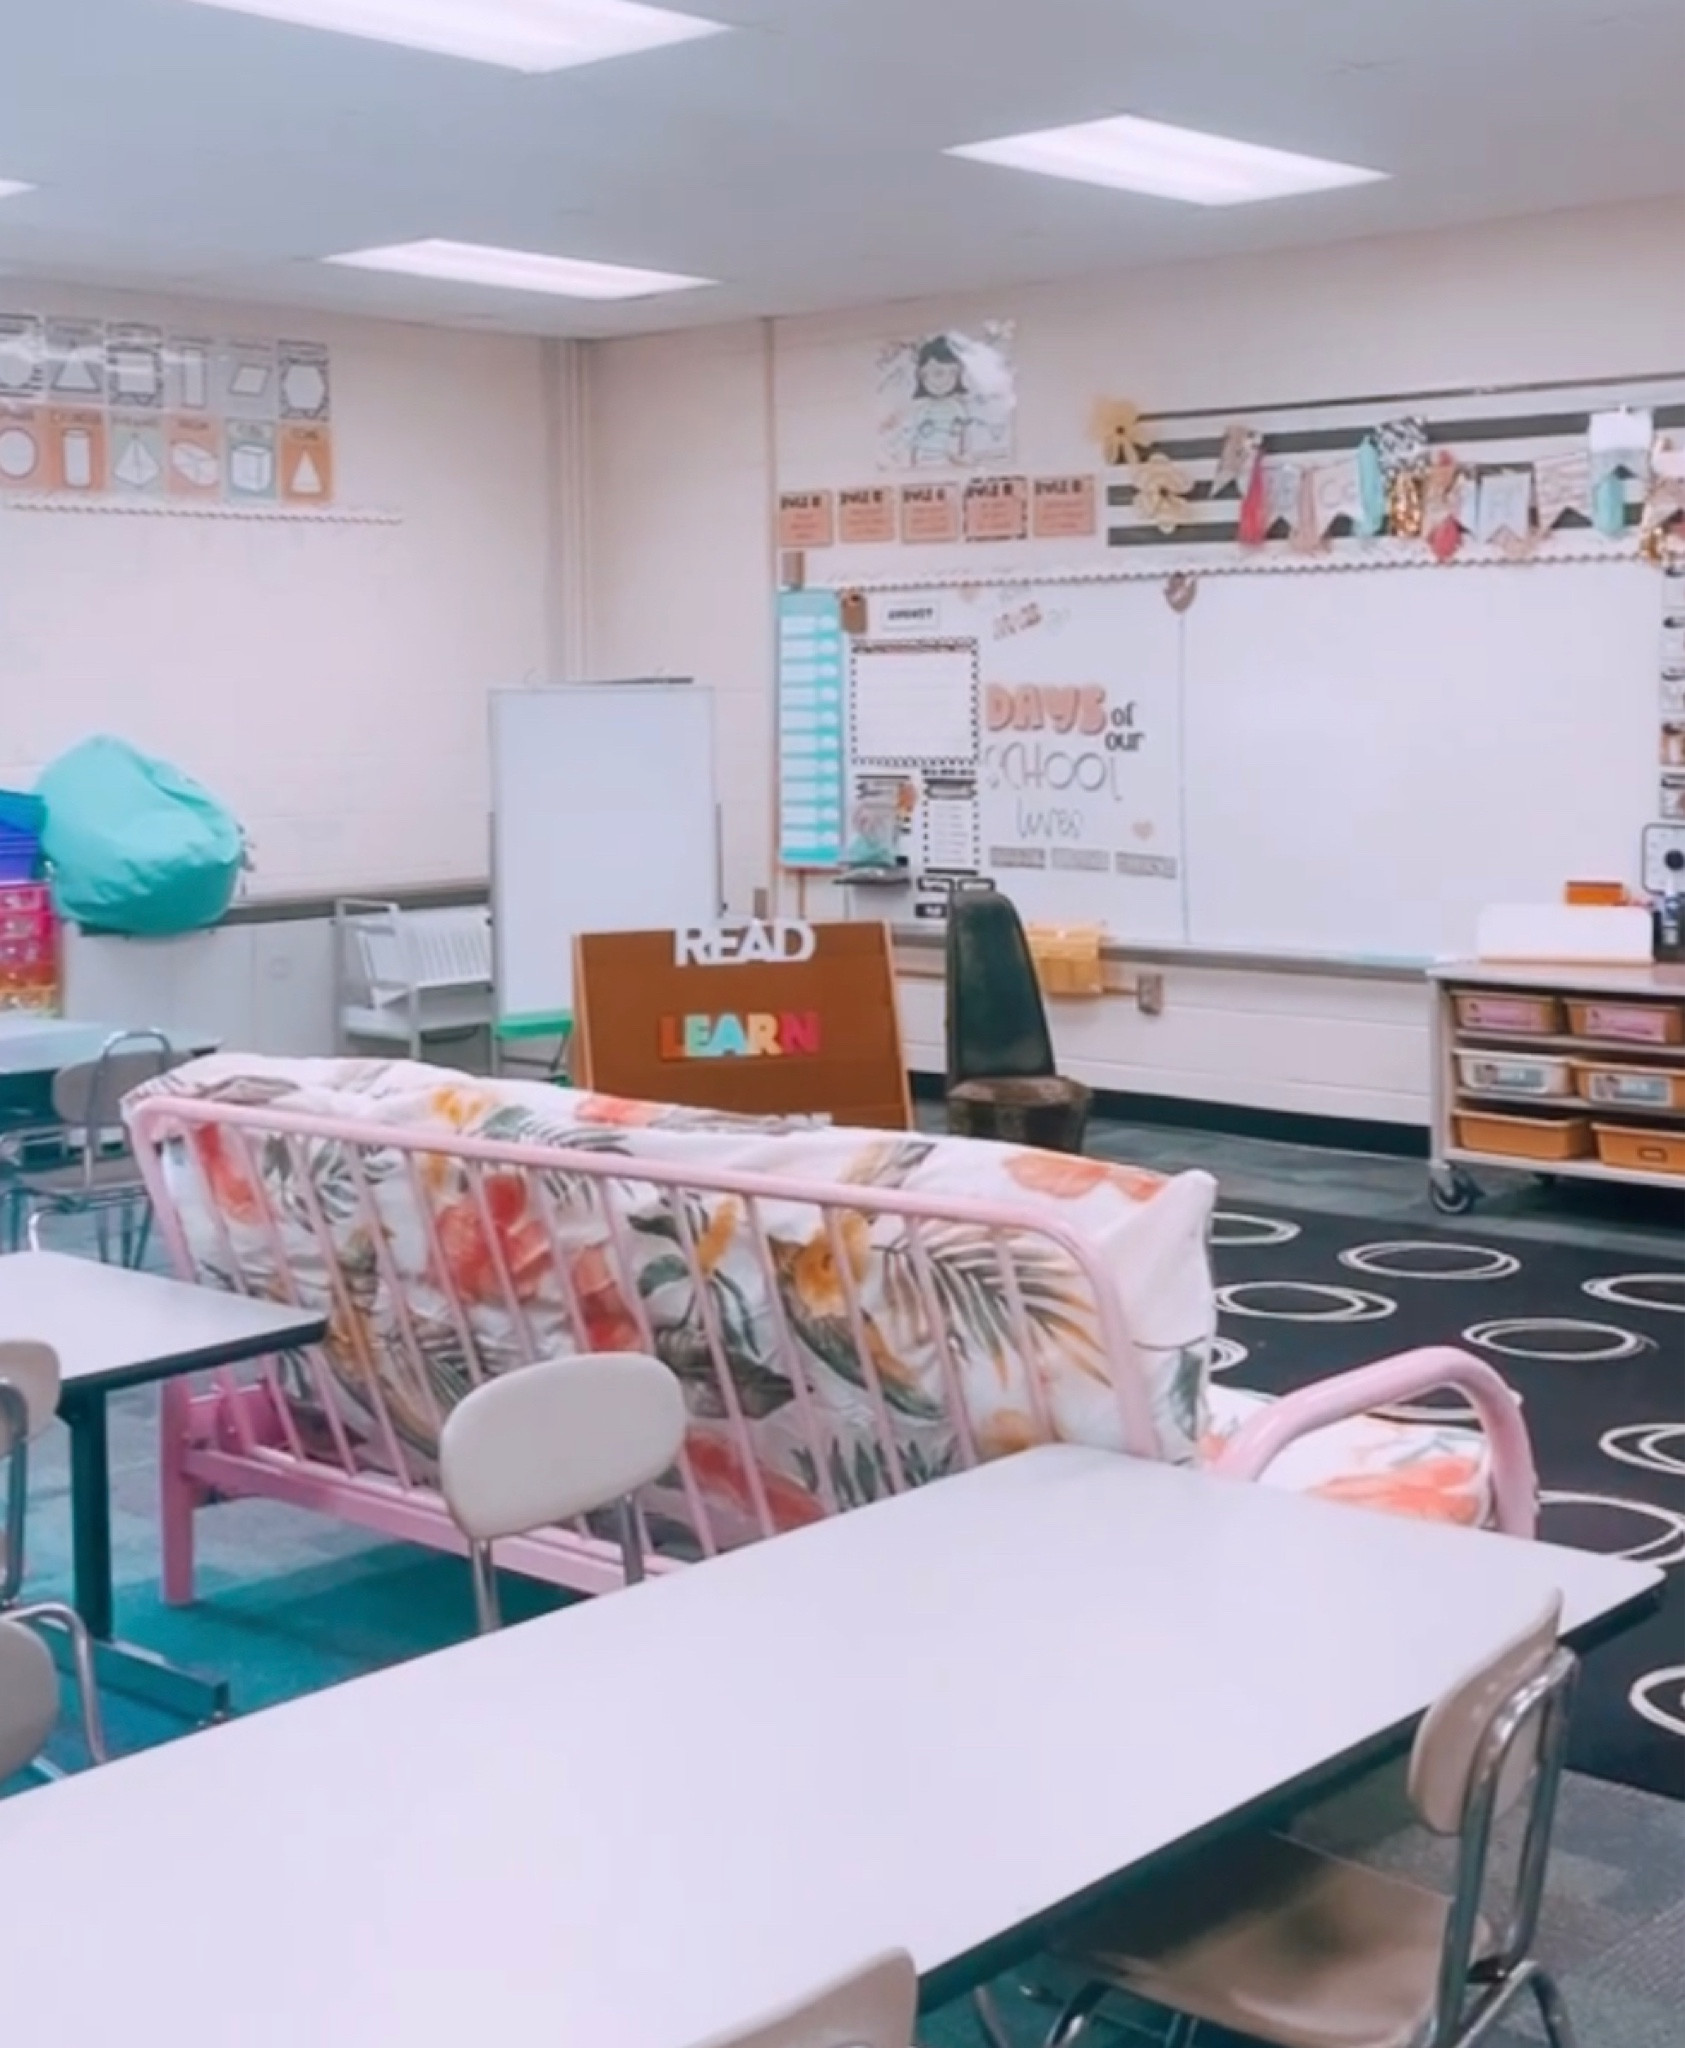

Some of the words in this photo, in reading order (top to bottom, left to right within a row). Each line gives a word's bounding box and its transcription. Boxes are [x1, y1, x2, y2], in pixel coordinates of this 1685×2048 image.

[986, 684, 1107, 736] DAYS
[1110, 700, 1136, 727] of
[1104, 730, 1144, 751] our
[674, 917, 816, 967] READ
[659, 1011, 822, 1062] LEARN
